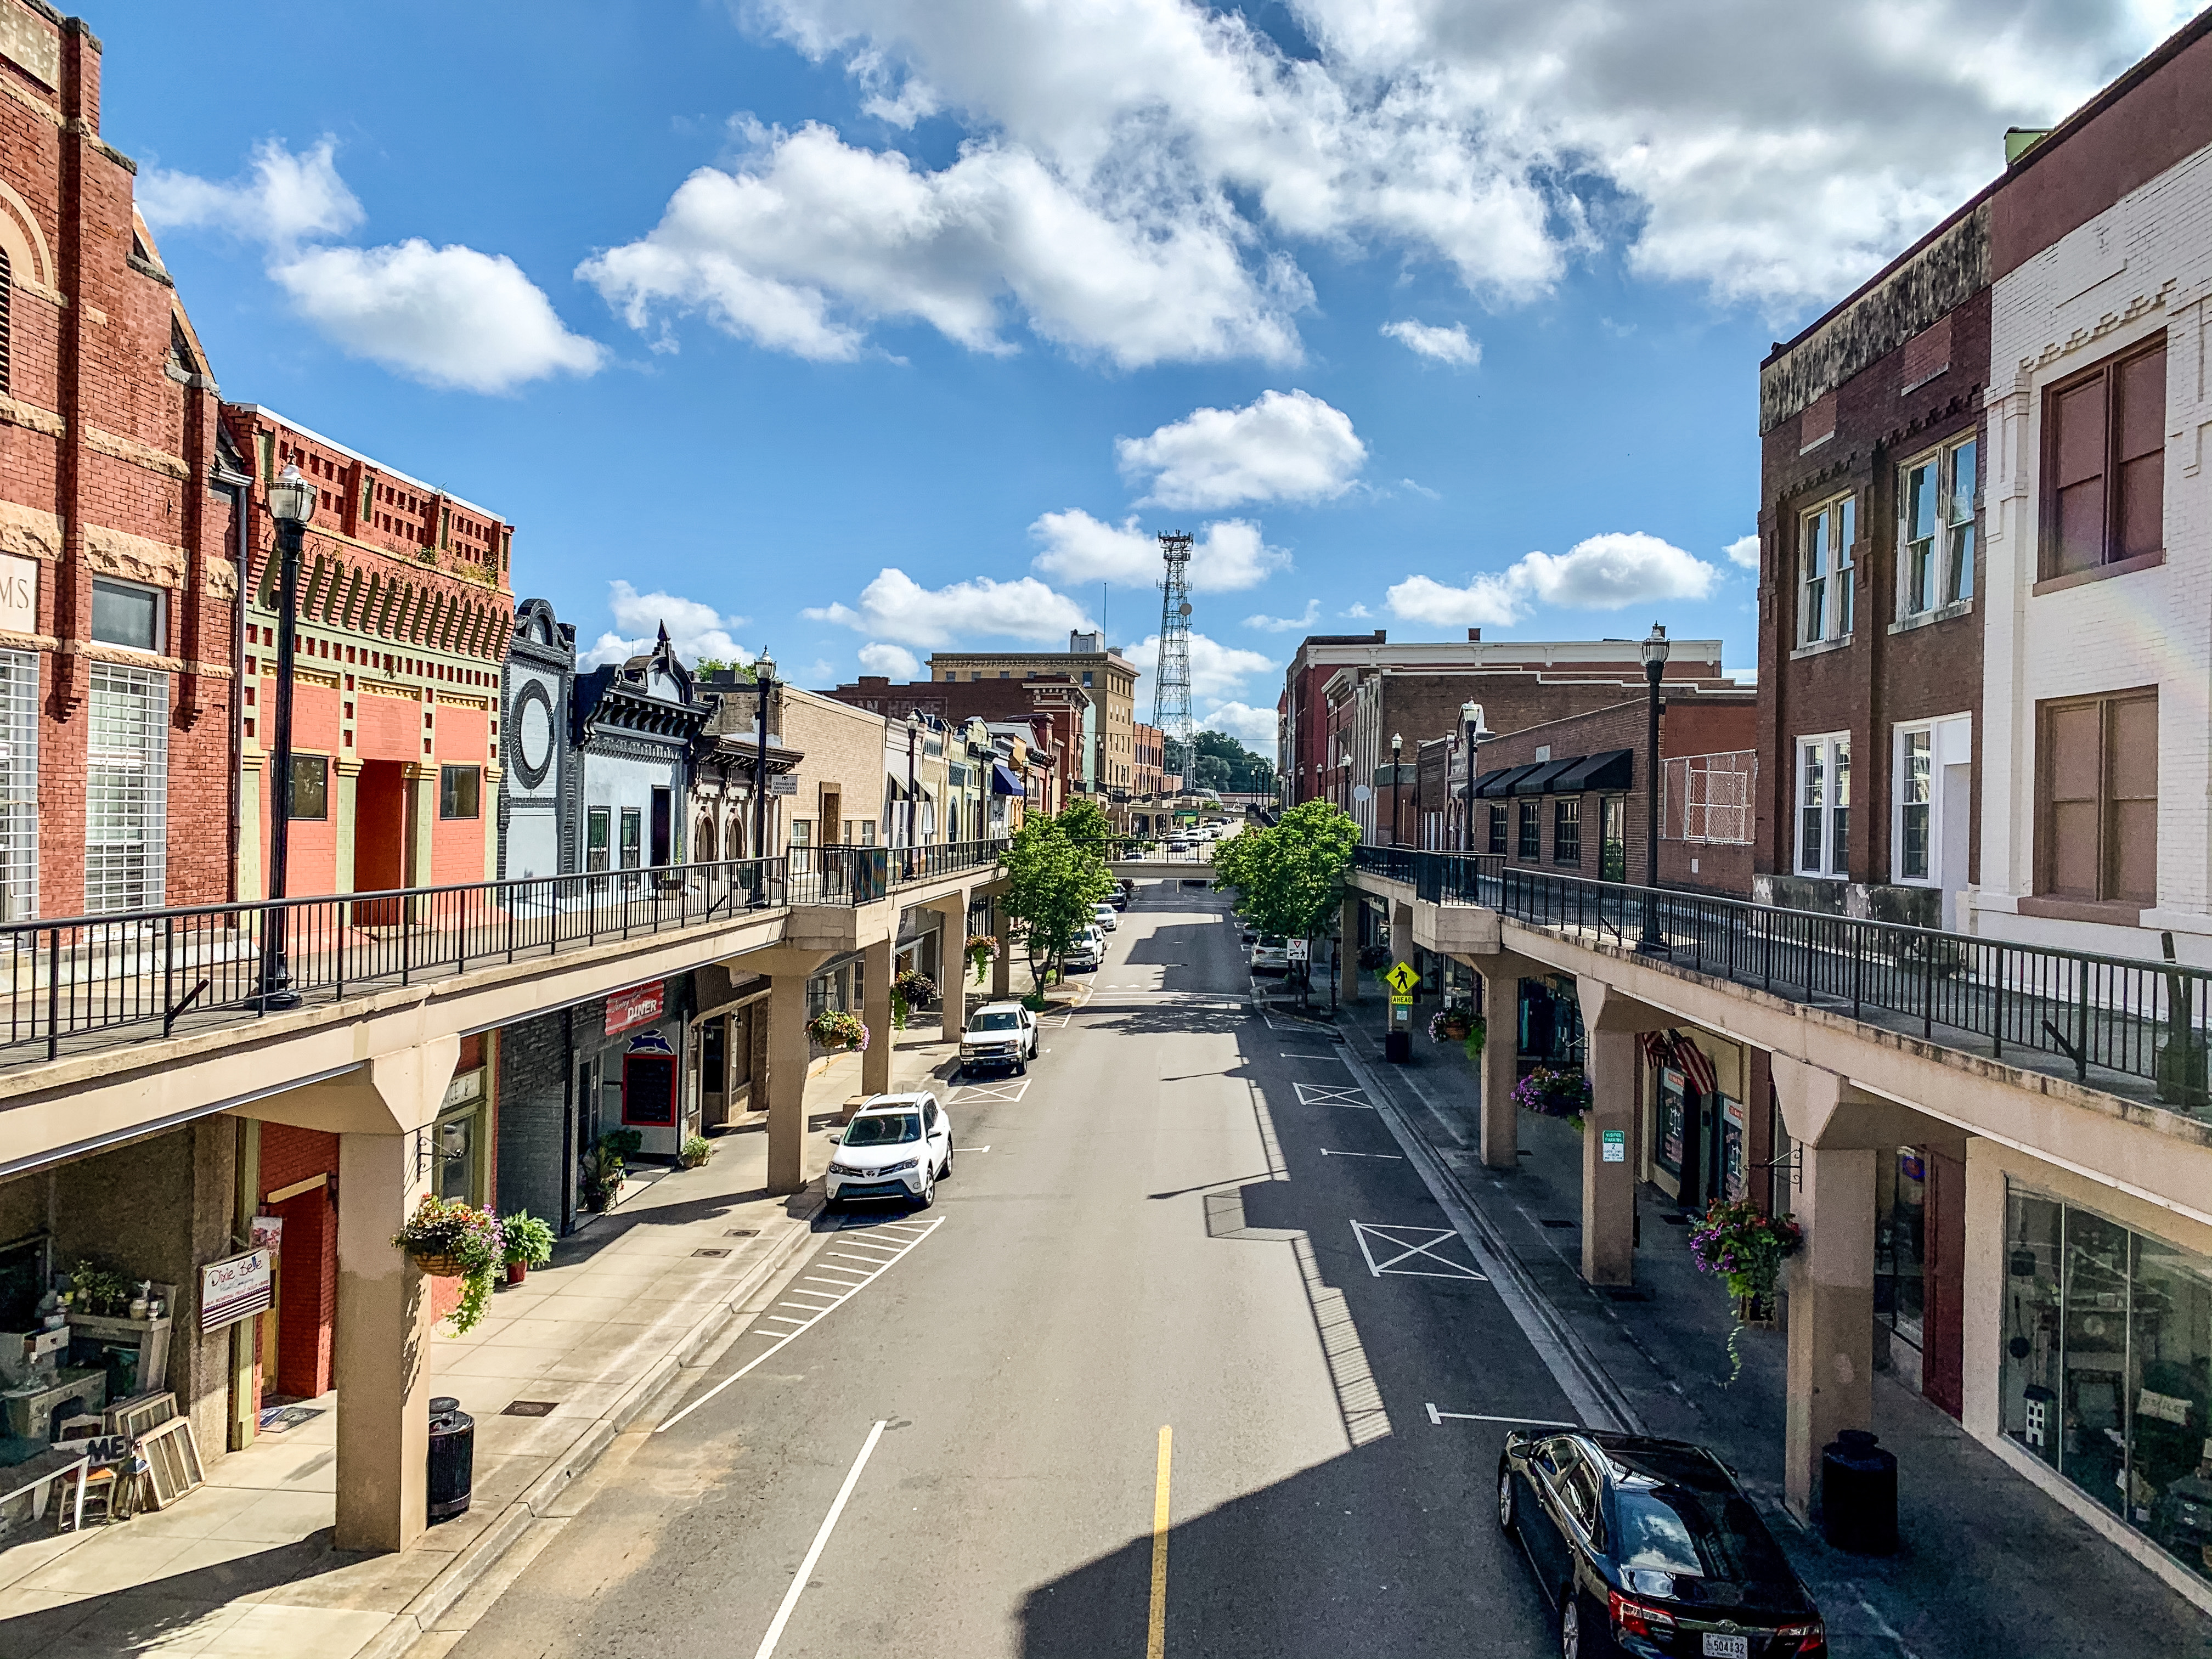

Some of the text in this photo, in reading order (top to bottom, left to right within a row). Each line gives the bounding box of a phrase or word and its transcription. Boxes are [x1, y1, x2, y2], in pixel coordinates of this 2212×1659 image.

[628, 999, 657, 1019] DINER
[237, 1255, 263, 1276] Belle
[87, 1435, 125, 1463] ME
